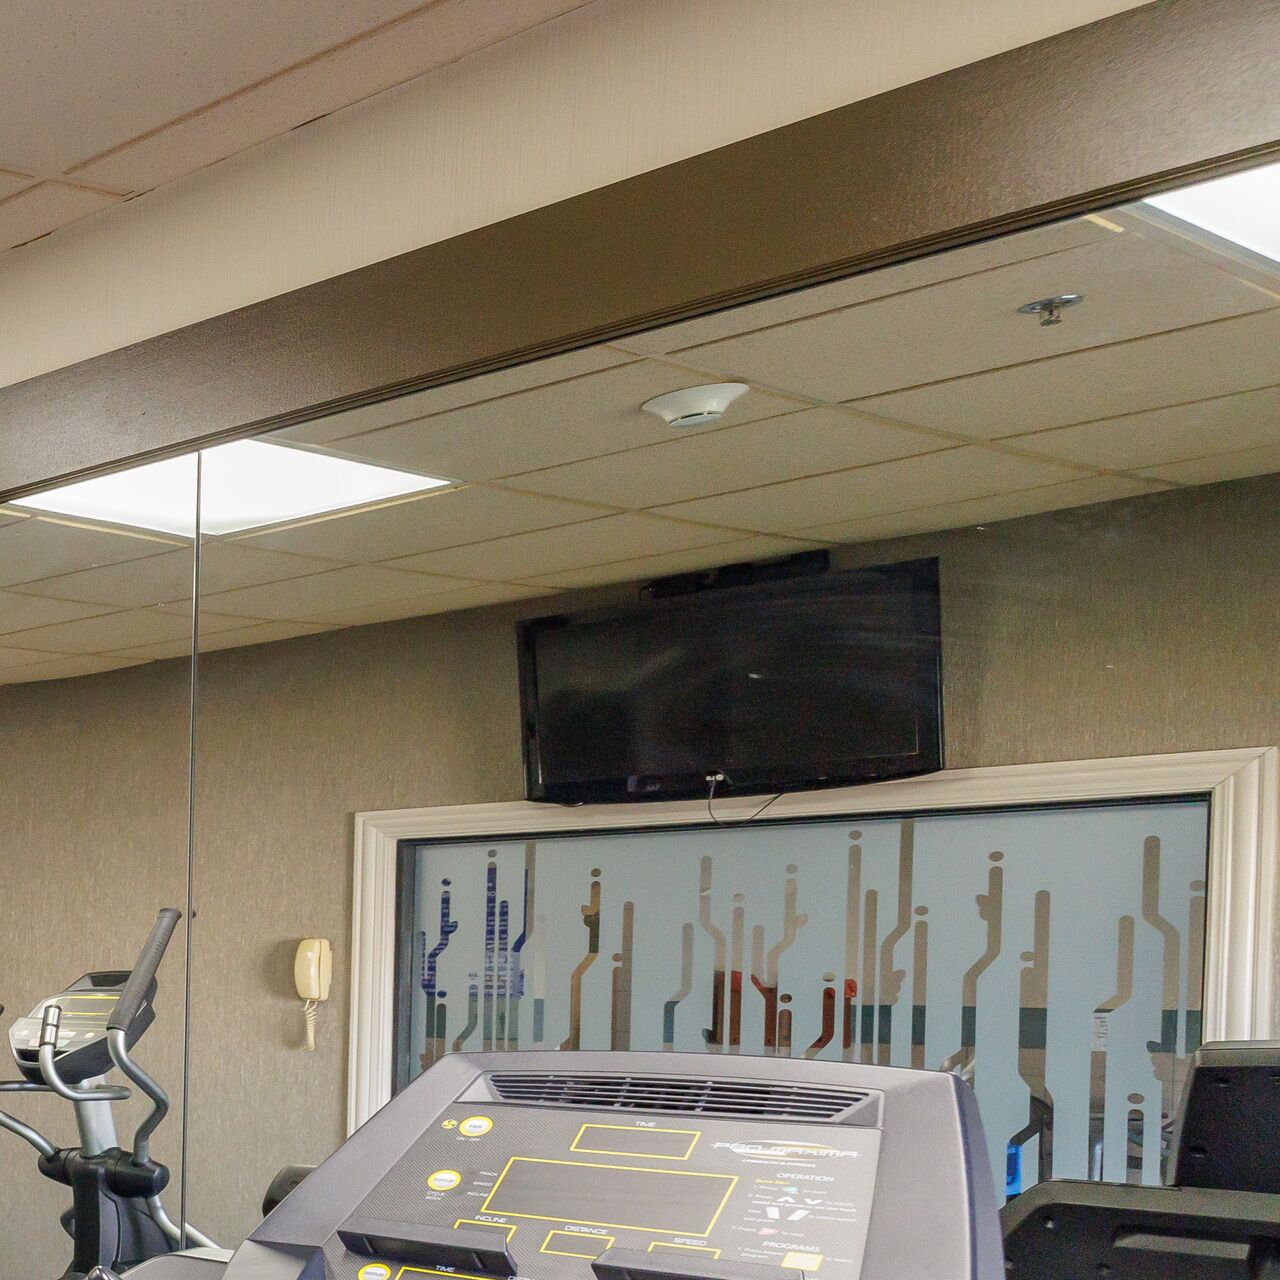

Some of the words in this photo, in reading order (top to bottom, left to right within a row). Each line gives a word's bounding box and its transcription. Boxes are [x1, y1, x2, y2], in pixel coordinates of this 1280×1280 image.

[776, 1172, 835, 1182] OPERATION
[475, 1214, 508, 1224] INCLINE
[564, 1225, 609, 1235] DISTANCE
[673, 1237, 707, 1247] SPEED
[762, 1240, 821, 1252] PROGRAMS
